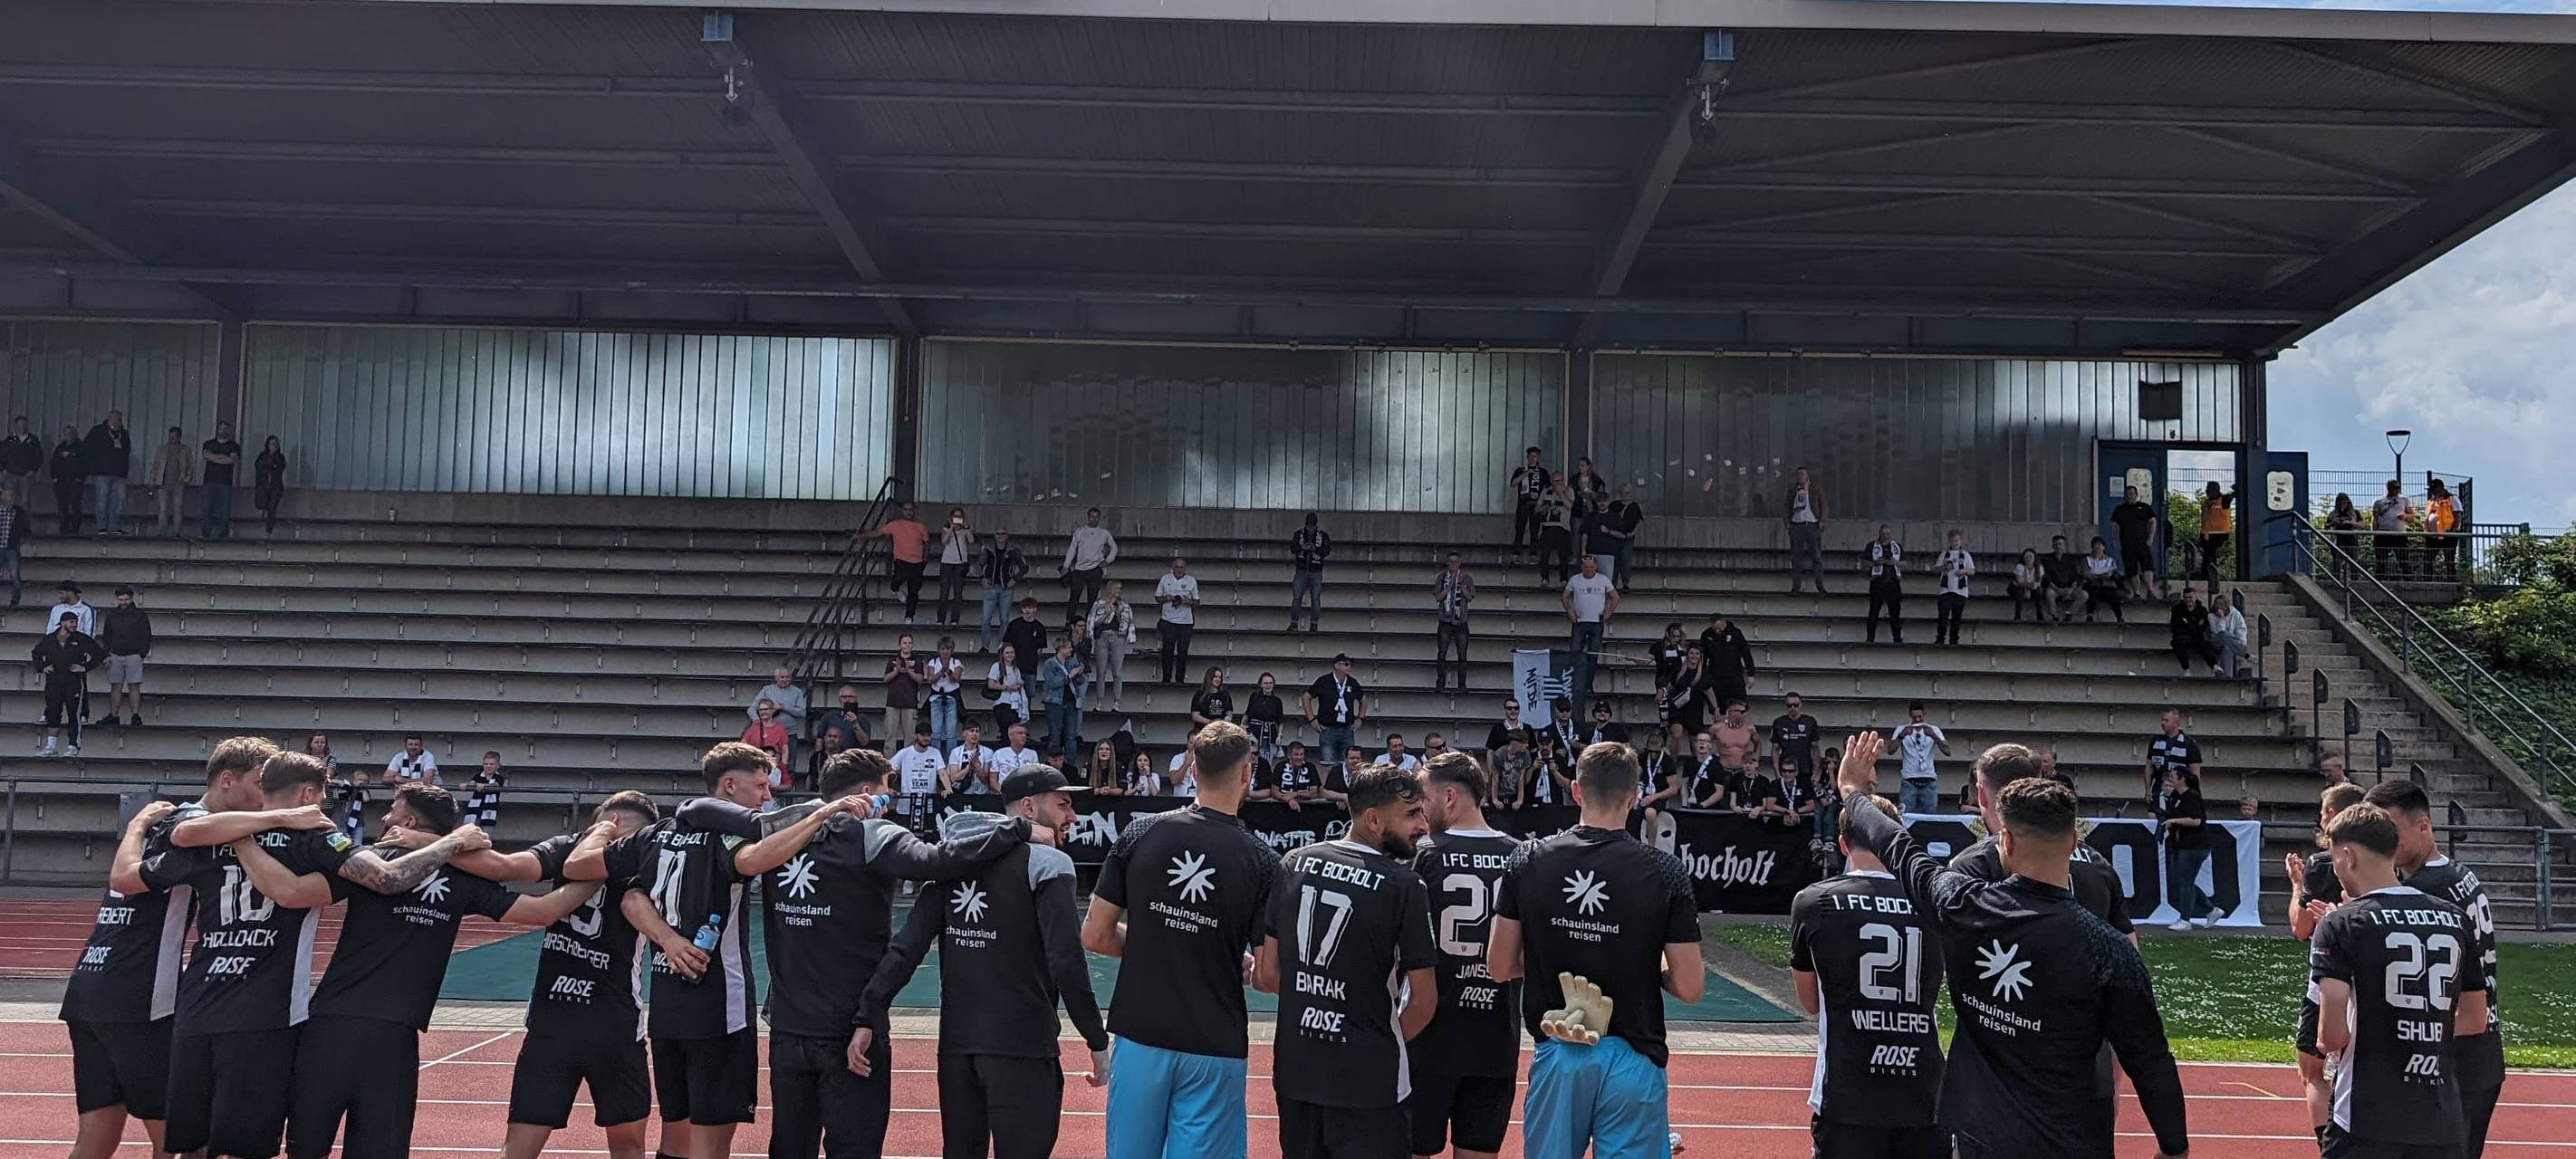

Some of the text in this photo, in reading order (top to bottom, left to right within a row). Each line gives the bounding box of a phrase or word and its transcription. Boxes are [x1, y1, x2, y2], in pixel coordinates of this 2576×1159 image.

[1321, 861, 1385, 891] BOCHOLT
[219, 865, 274, 926] 10
[1848, 895, 1872, 912] FC
[393, 905, 451, 922] schauinsland
[405, 914, 434, 926] reisen
[785, 915, 812, 927] reisen
[1149, 901, 1217, 929] schauinsland
[1551, 915, 1620, 934] schauinsland
[2382, 909, 2402, 920] FC
[2403, 909, 2464, 930] BOCHOLT
[1165, 916, 1198, 934] reisen
[1297, 885, 1353, 970] 17
[1569, 928, 1601, 943] reisen
[956, 937, 985, 949] reisen
[1860, 922, 1922, 1005] 21
[2385, 932, 2462, 1012] 22
[551, 975, 596, 997] ROSE
[1296, 972, 1346, 1001] BARAK
[1459, 986, 1498, 1003] ROSE
[1458, 1000, 1494, 1011] BIKES
[1962, 992, 2042, 1031] schauinsland
[1301, 1007, 1345, 1032] ROSE
[1851, 1010, 1930, 1034] WELLERS
[1979, 1014, 2016, 1037] reisen
[1870, 1044, 1920, 1068] ROSE
[1870, 1067, 1918, 1077] BIKES
